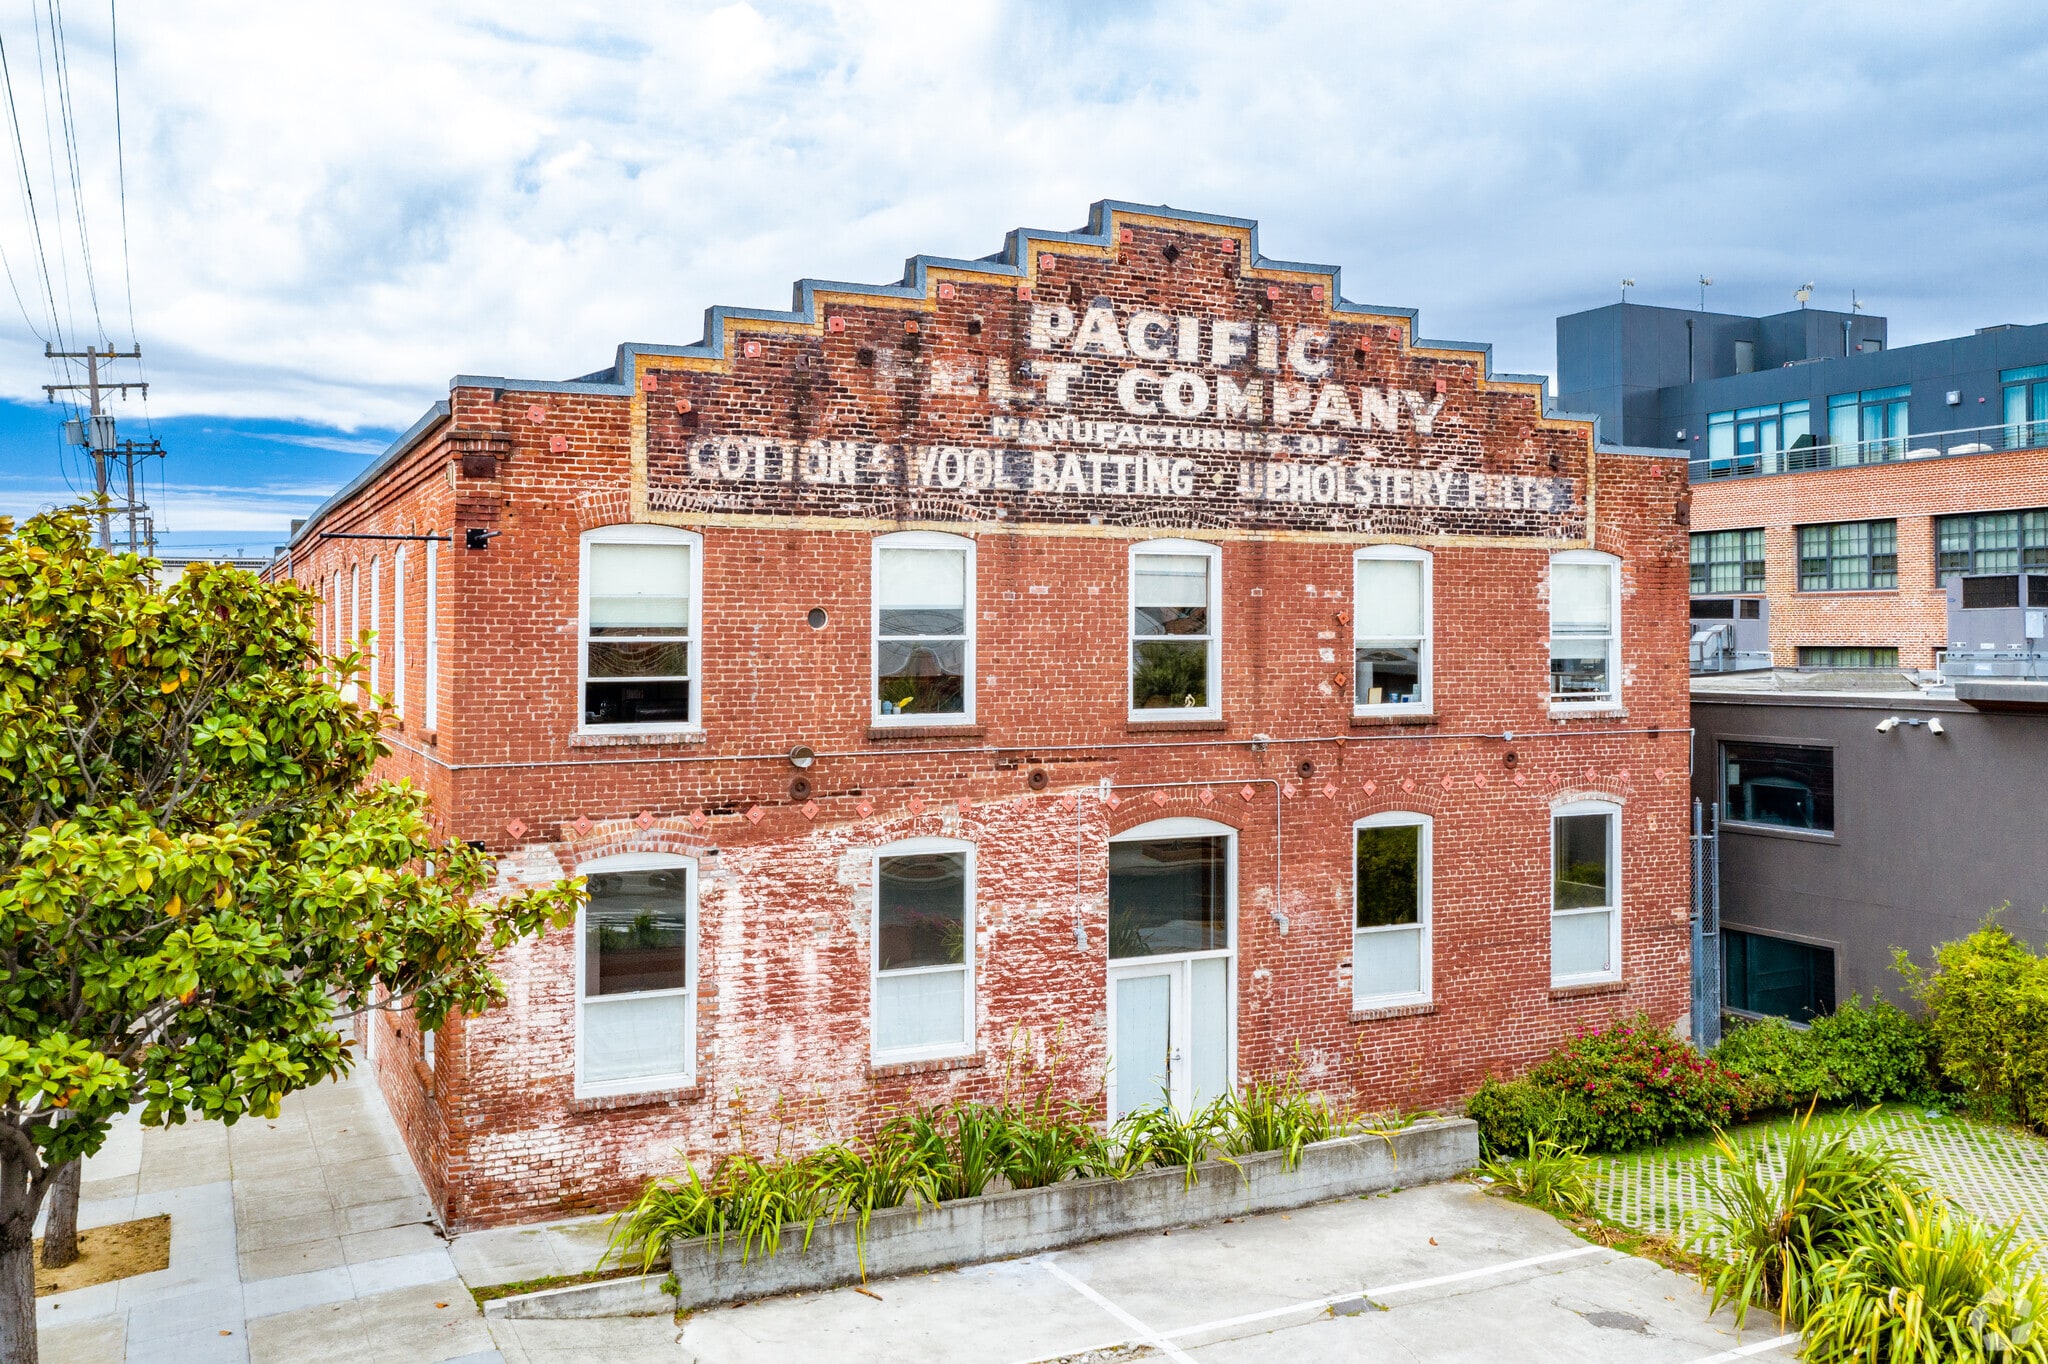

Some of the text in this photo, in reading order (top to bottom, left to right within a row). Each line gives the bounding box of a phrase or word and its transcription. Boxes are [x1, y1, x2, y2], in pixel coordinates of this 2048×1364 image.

[1030, 298, 1333, 377] PACIFIC
[1117, 367, 1446, 434] COMPANY
[688, 436, 856, 485] COTTON
[907, 446, 1023, 488] WOOL
[1034, 450, 1194, 495] BATTING
[1240, 462, 1452, 506] UPHOLSTERY
[1301, 435, 1340, 455] OF
